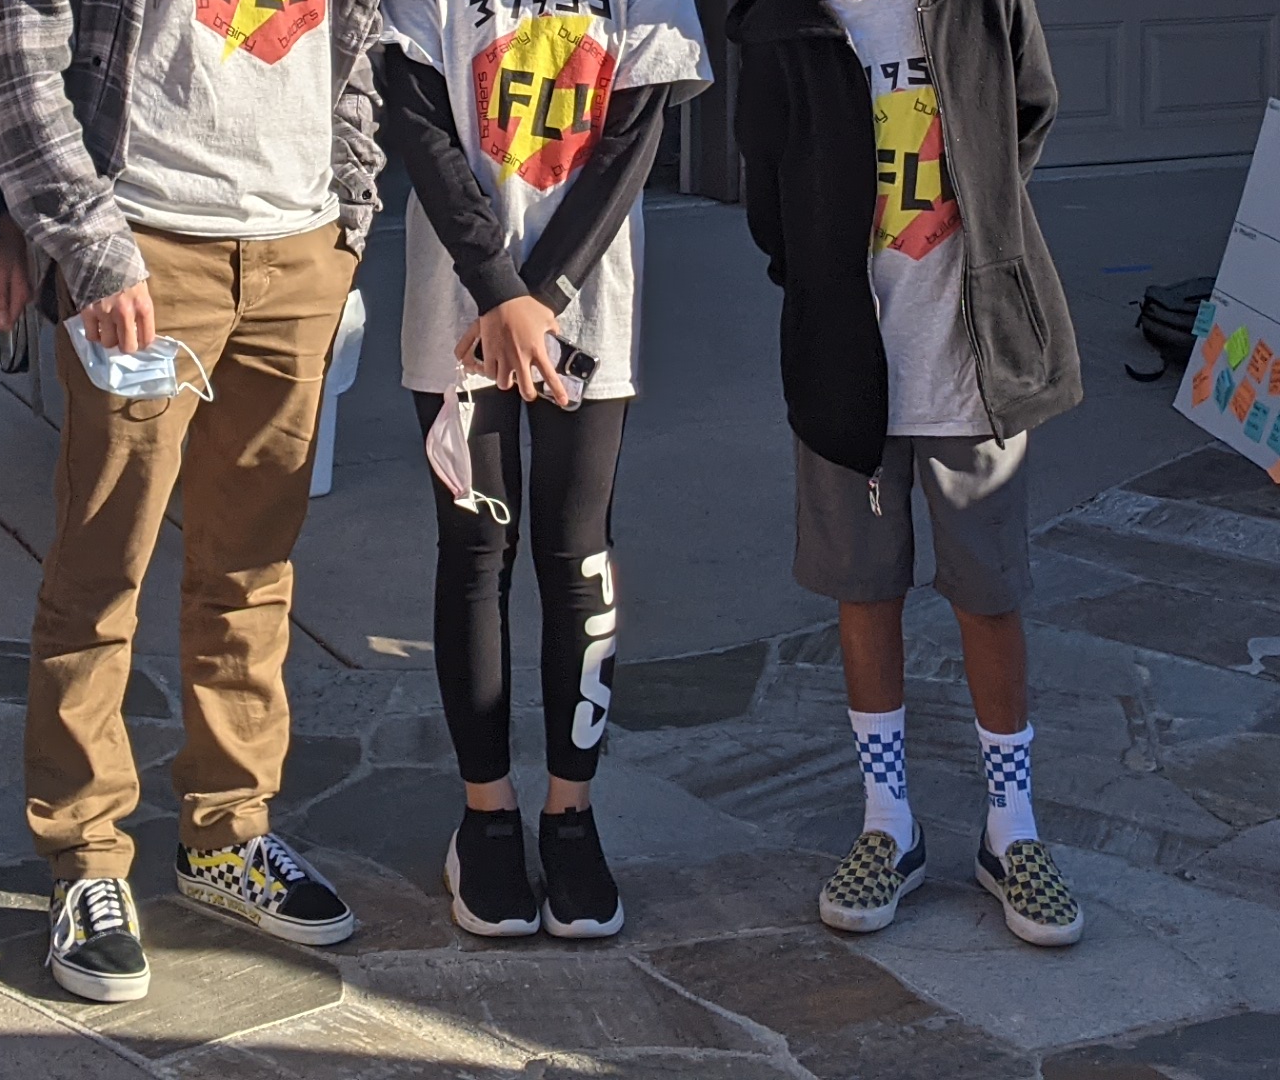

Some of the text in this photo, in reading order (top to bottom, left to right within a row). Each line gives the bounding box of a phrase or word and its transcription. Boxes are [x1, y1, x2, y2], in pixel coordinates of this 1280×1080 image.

[213, 13, 257, 52] brainy
[486, 31, 531, 64] brainy
[558, 25, 608, 67] builders
[478, 71, 490, 139] builders
[498, 67, 592, 141] FLL
[490, 144, 531, 177] brainy
